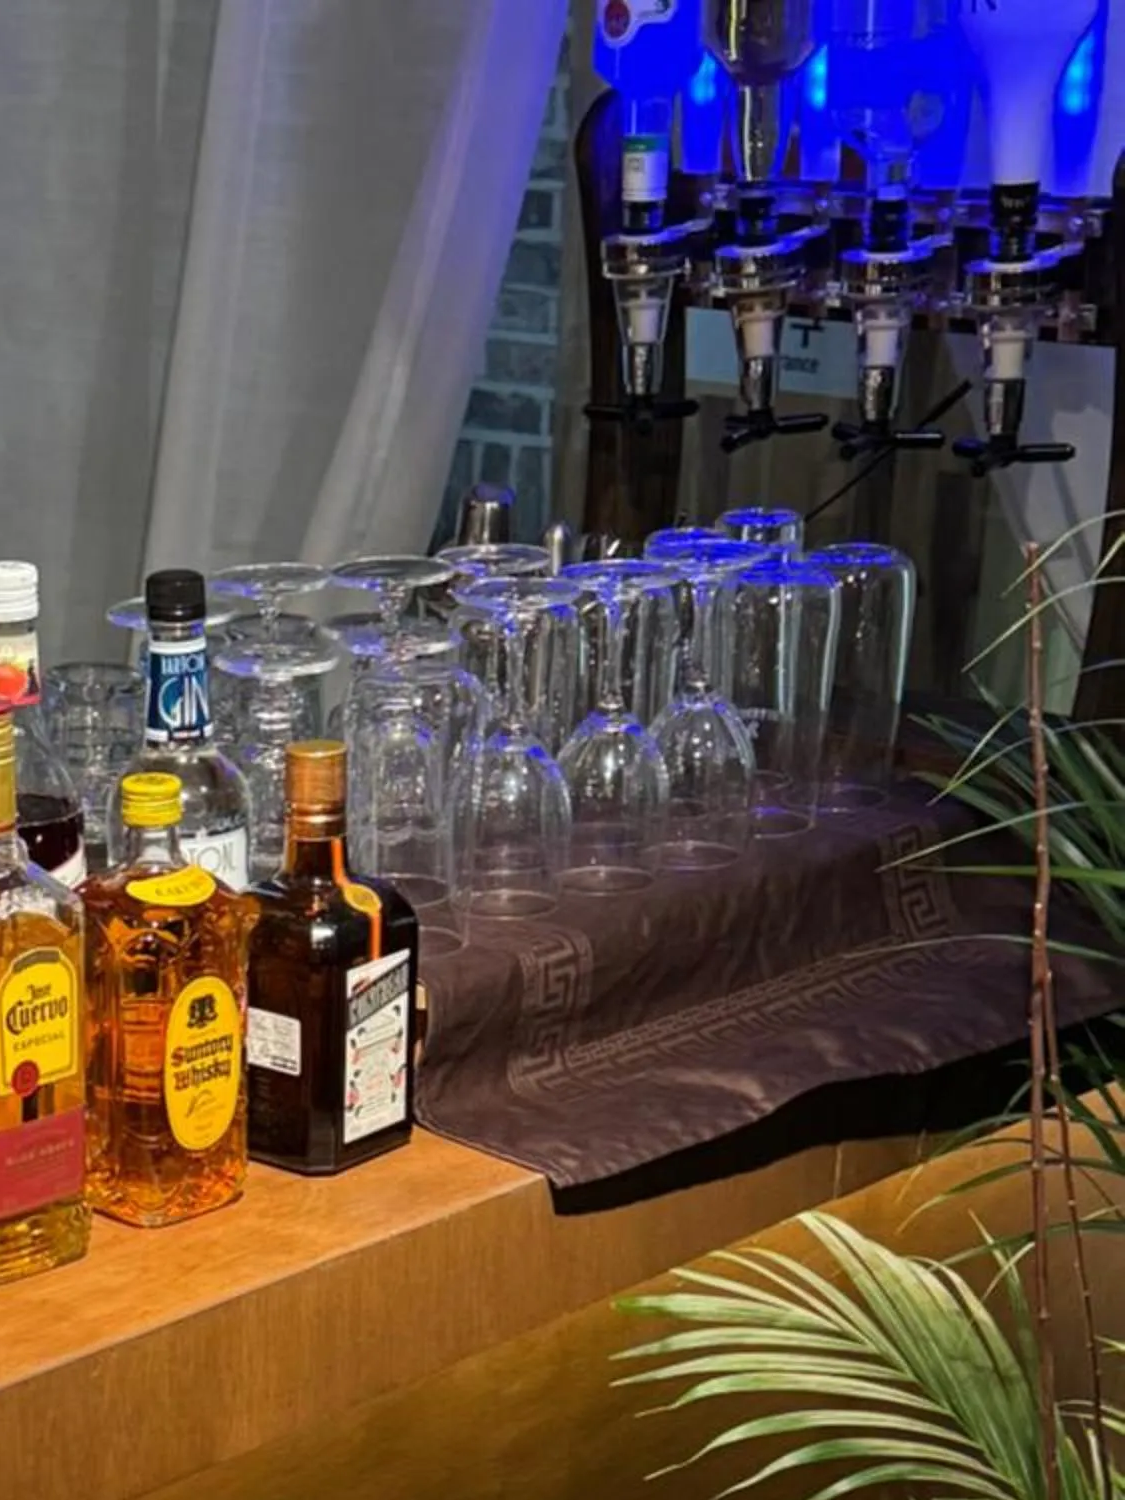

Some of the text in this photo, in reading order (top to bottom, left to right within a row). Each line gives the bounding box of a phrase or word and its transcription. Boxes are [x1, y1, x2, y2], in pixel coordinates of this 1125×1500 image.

[158, 673, 211, 727] GIN
[6, 995, 69, 1036] Cuervo
[171, 1034, 234, 1068] Suntory
[174, 1058, 233, 1093] Whisky
